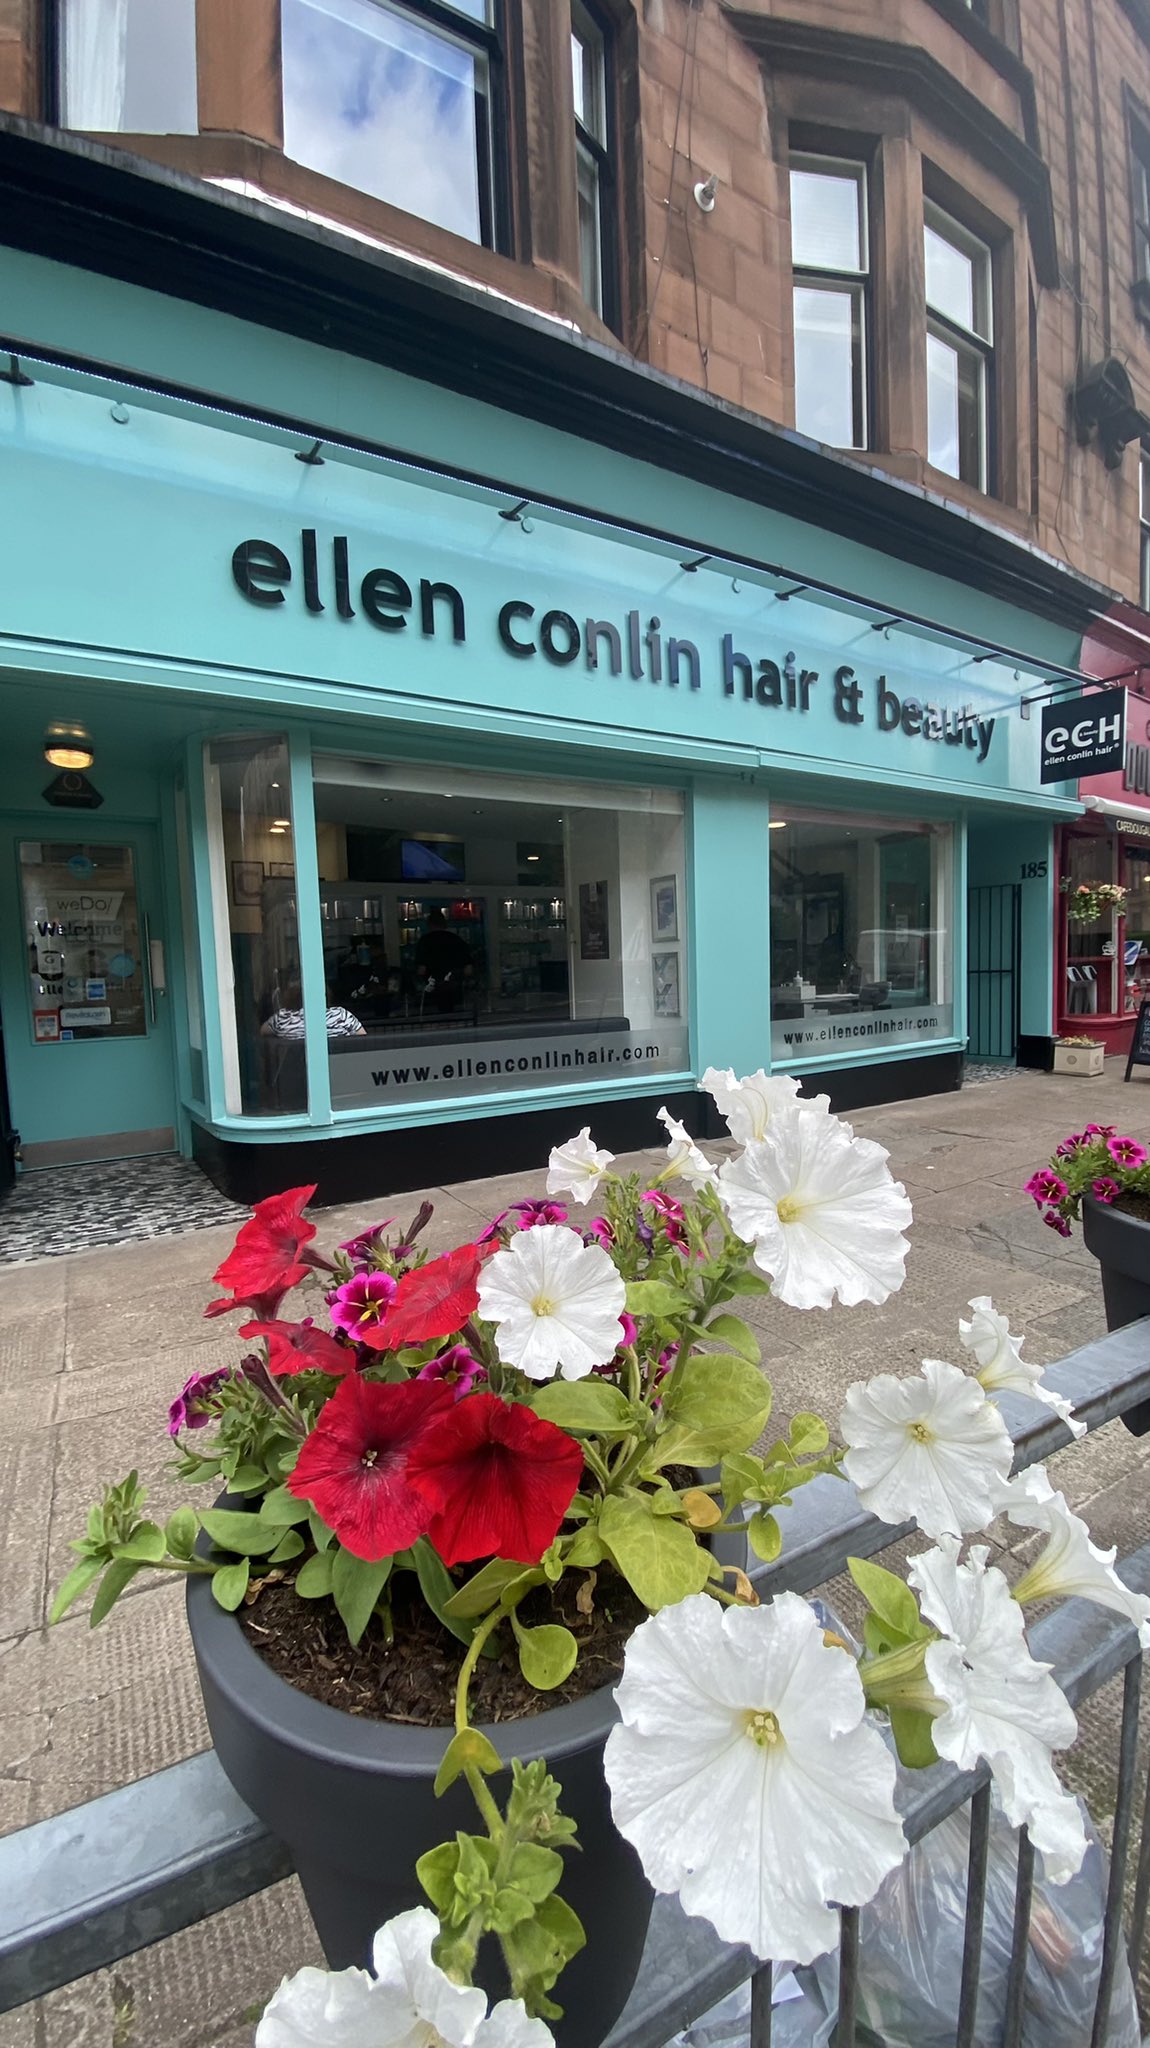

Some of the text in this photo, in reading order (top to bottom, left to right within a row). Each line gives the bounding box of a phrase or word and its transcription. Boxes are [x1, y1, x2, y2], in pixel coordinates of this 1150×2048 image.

[232, 528, 996, 764] ellen conlin hair & beauty
[1044, 756, 1065, 766] ellen
[1066, 750, 1093, 761] conlin
[1020, 861, 1047, 879] 185
[783, 1016, 938, 1045] www.ellenconlinhair.com
[371, 1043, 660, 1087] www.ellenconlinhair.com
